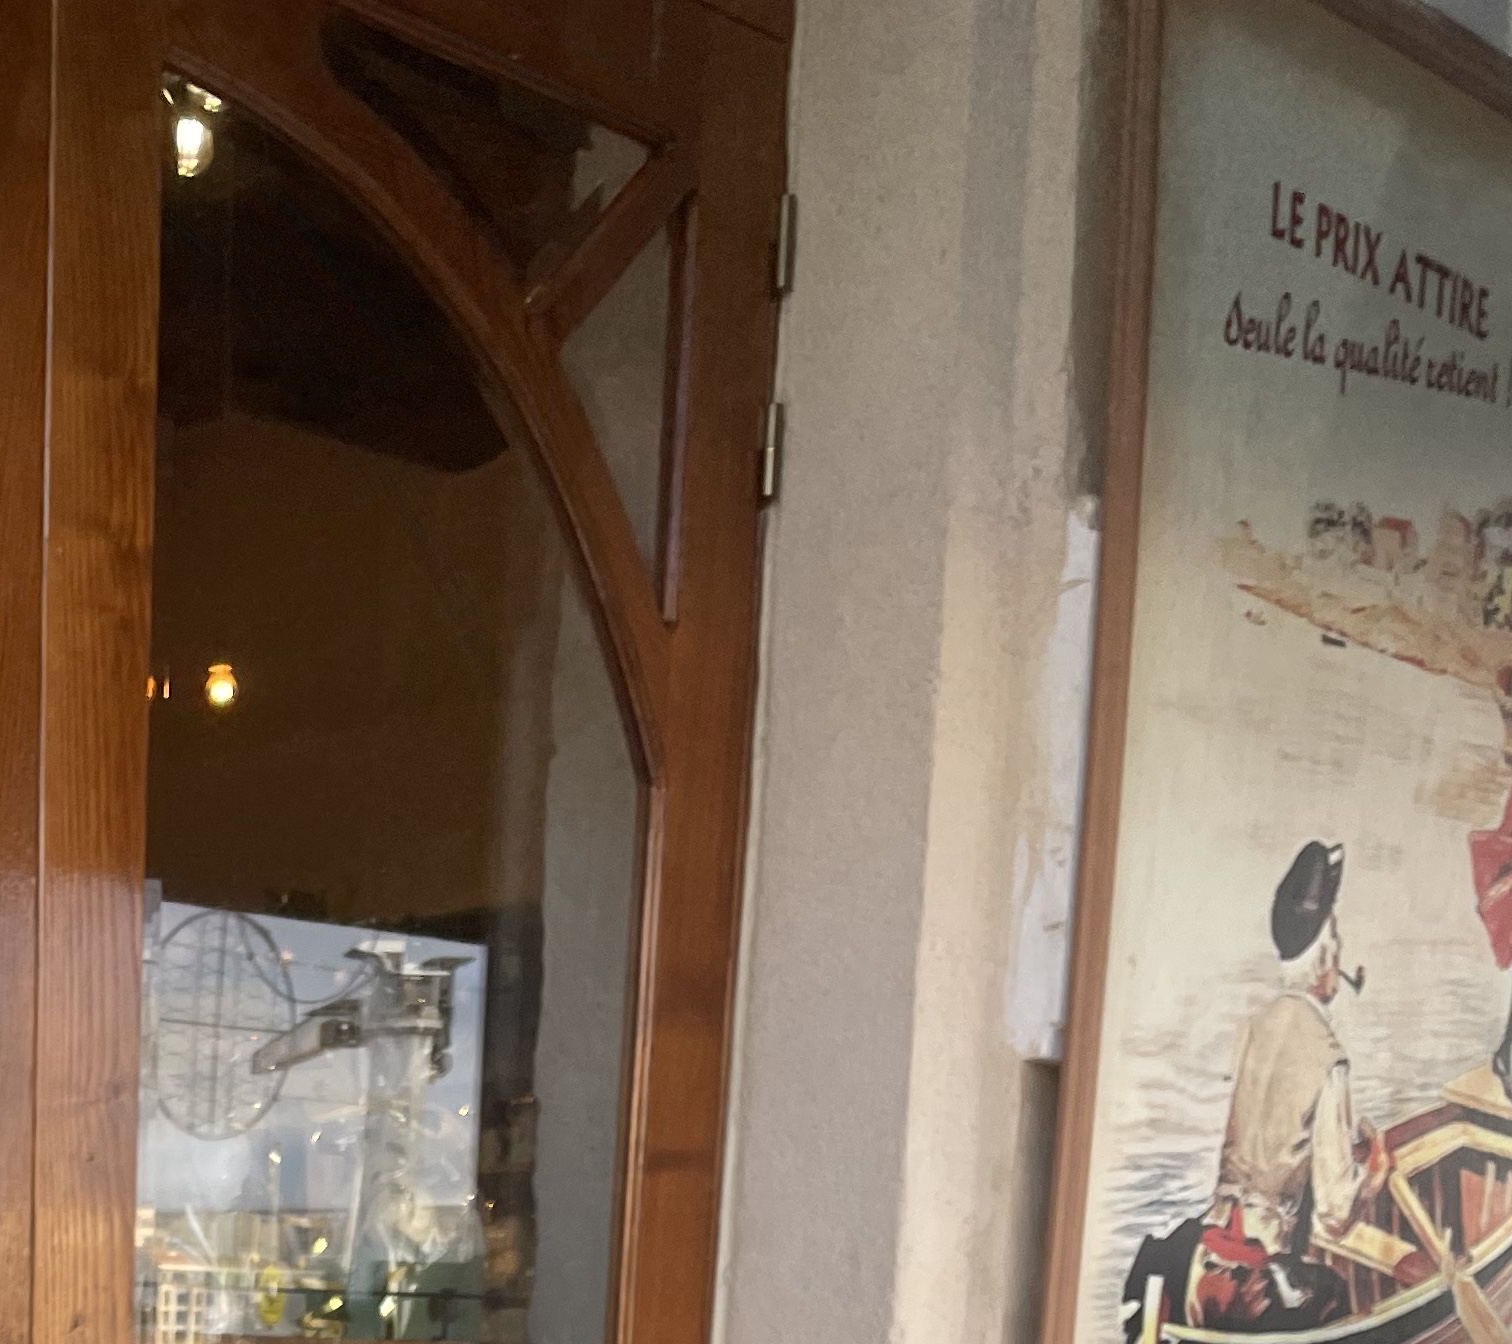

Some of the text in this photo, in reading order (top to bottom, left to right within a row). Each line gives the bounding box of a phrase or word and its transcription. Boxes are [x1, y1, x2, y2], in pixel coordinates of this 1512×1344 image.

[1271, 180, 1490, 341] LE PRIX ATTIRE
[1224, 291, 1296, 358] Seule
[1303, 299, 1326, 365] la
[1334, 318, 1425, 395] qualité
